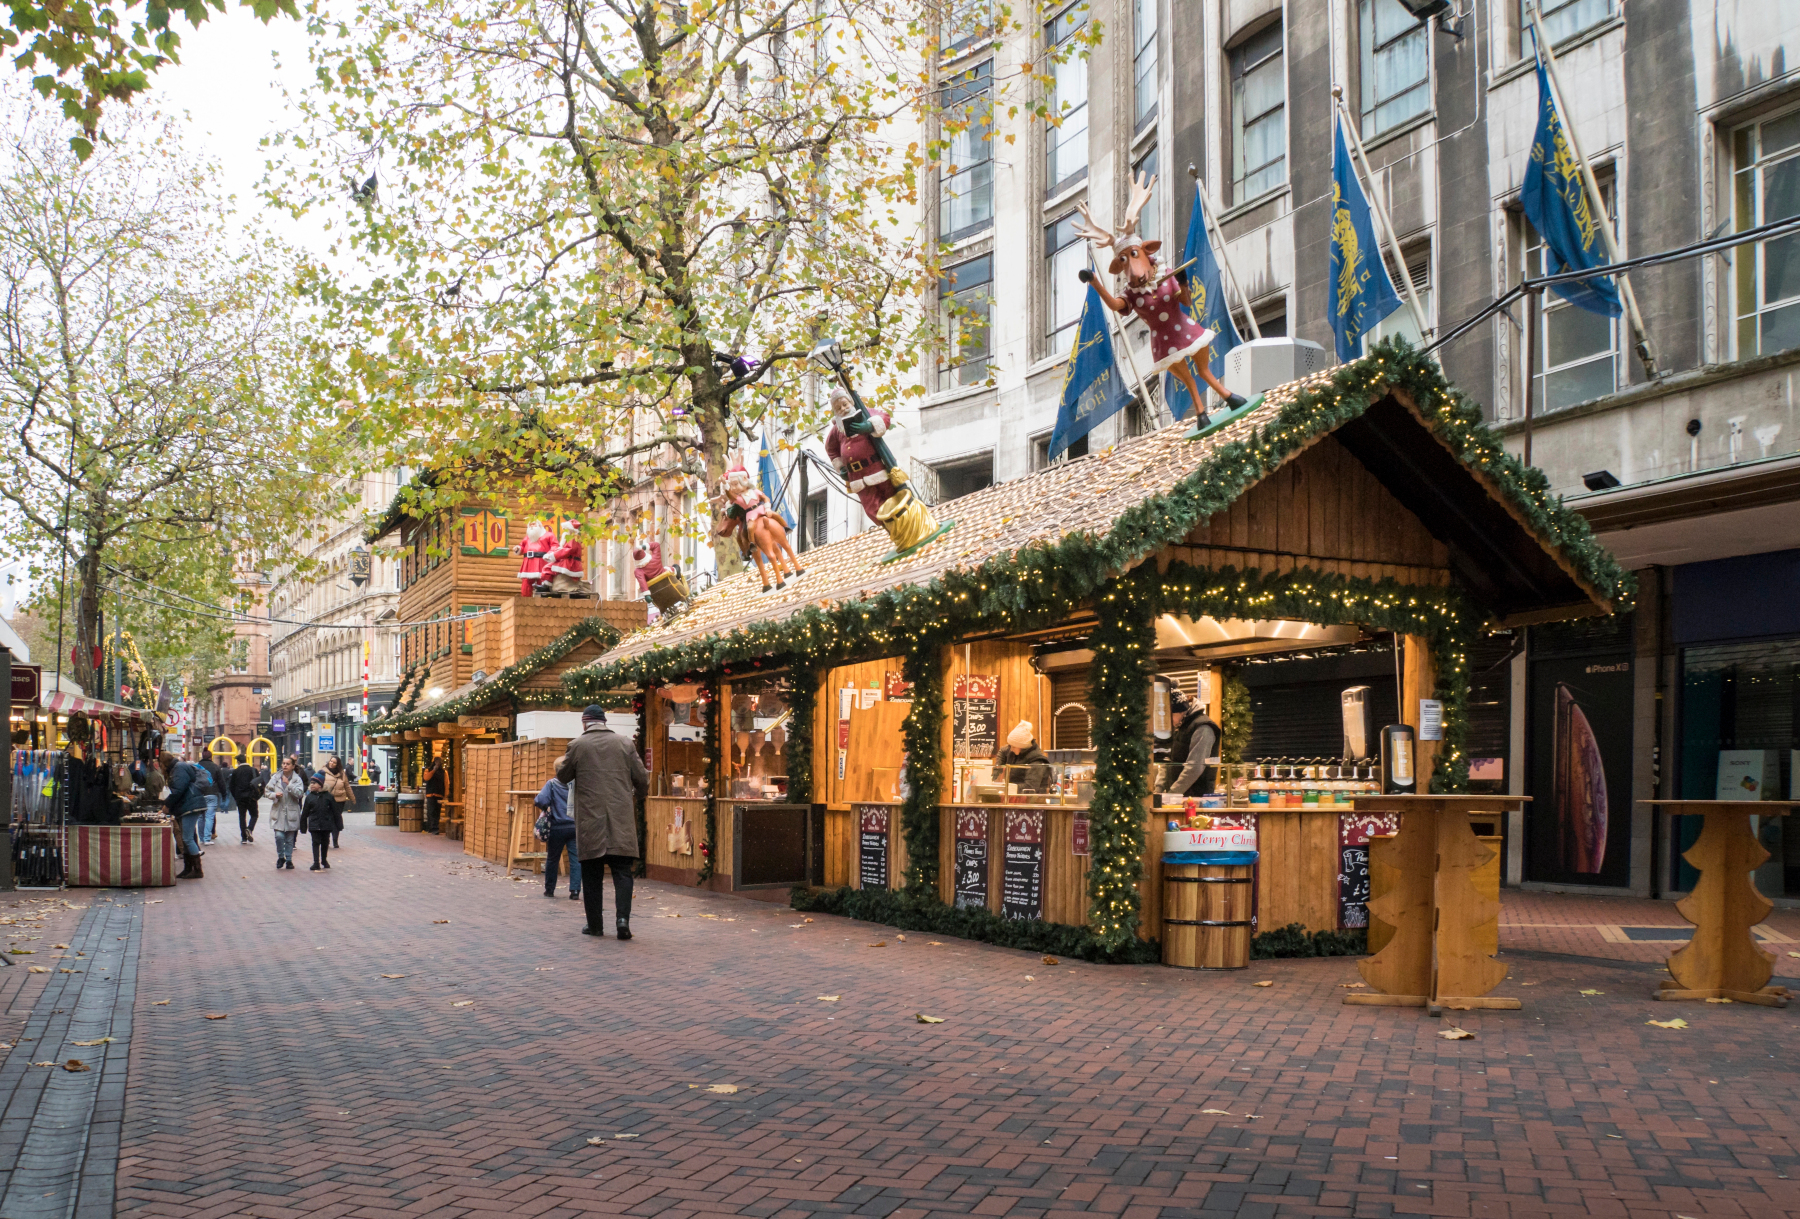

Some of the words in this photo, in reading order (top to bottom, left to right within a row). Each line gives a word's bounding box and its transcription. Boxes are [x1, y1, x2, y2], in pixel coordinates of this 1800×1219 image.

[469, 521, 502, 544] 10
[1591, 664, 1616, 673] iPhone
[1189, 833, 1227, 848] Merry
